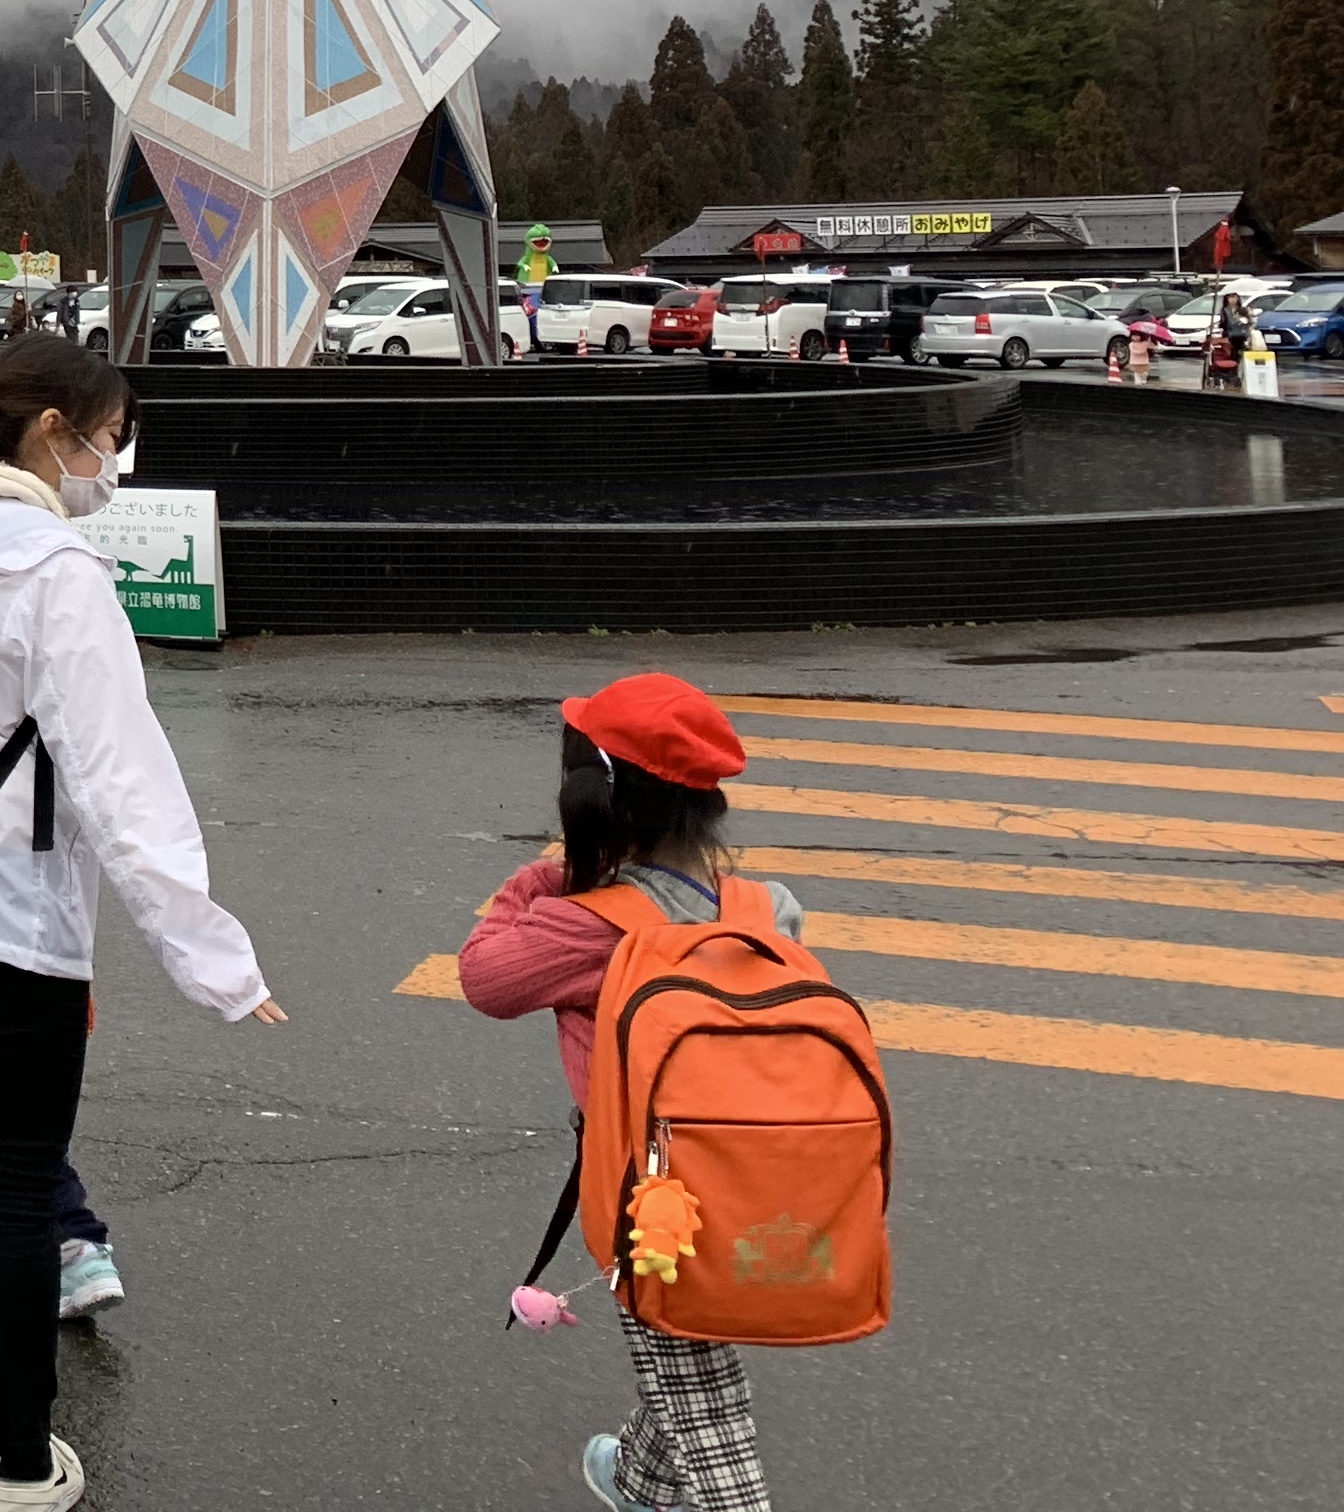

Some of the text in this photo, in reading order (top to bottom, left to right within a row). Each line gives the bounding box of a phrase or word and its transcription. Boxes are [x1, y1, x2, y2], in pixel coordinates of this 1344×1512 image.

[820, 217, 989, 233] 無料休憩所 おみやげ
[96, 523, 115, 533] you
[119, 523, 147, 534] again
[151, 525, 179, 534] soon.
